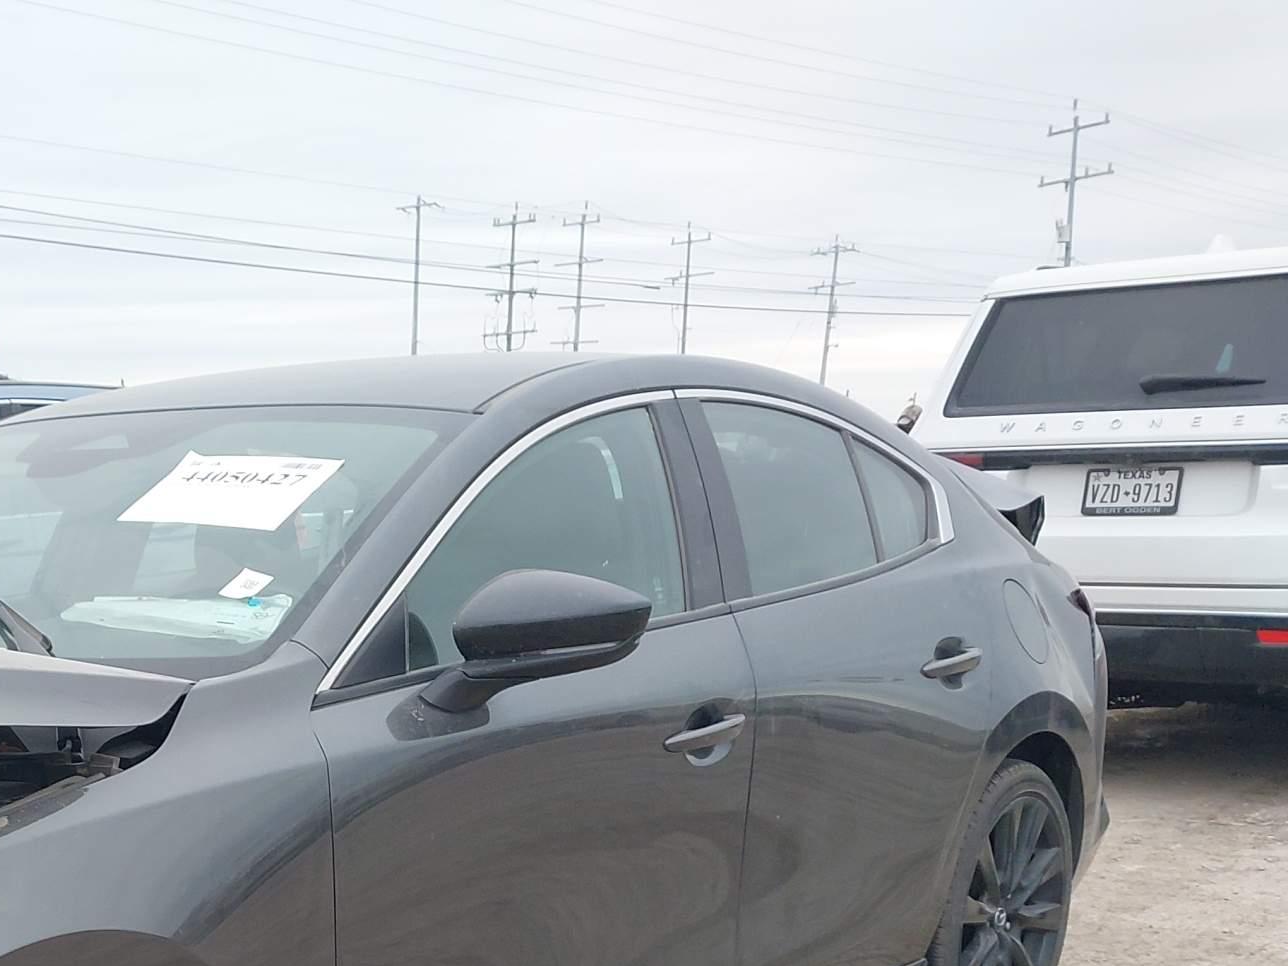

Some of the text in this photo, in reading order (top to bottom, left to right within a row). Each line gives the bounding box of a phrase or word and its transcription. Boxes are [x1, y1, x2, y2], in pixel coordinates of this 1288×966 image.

[999, 413, 1288, 433] WAGONEER
[182, 471, 308, 486] 44050427
[1117, 468, 1152, 480] TEXAS
